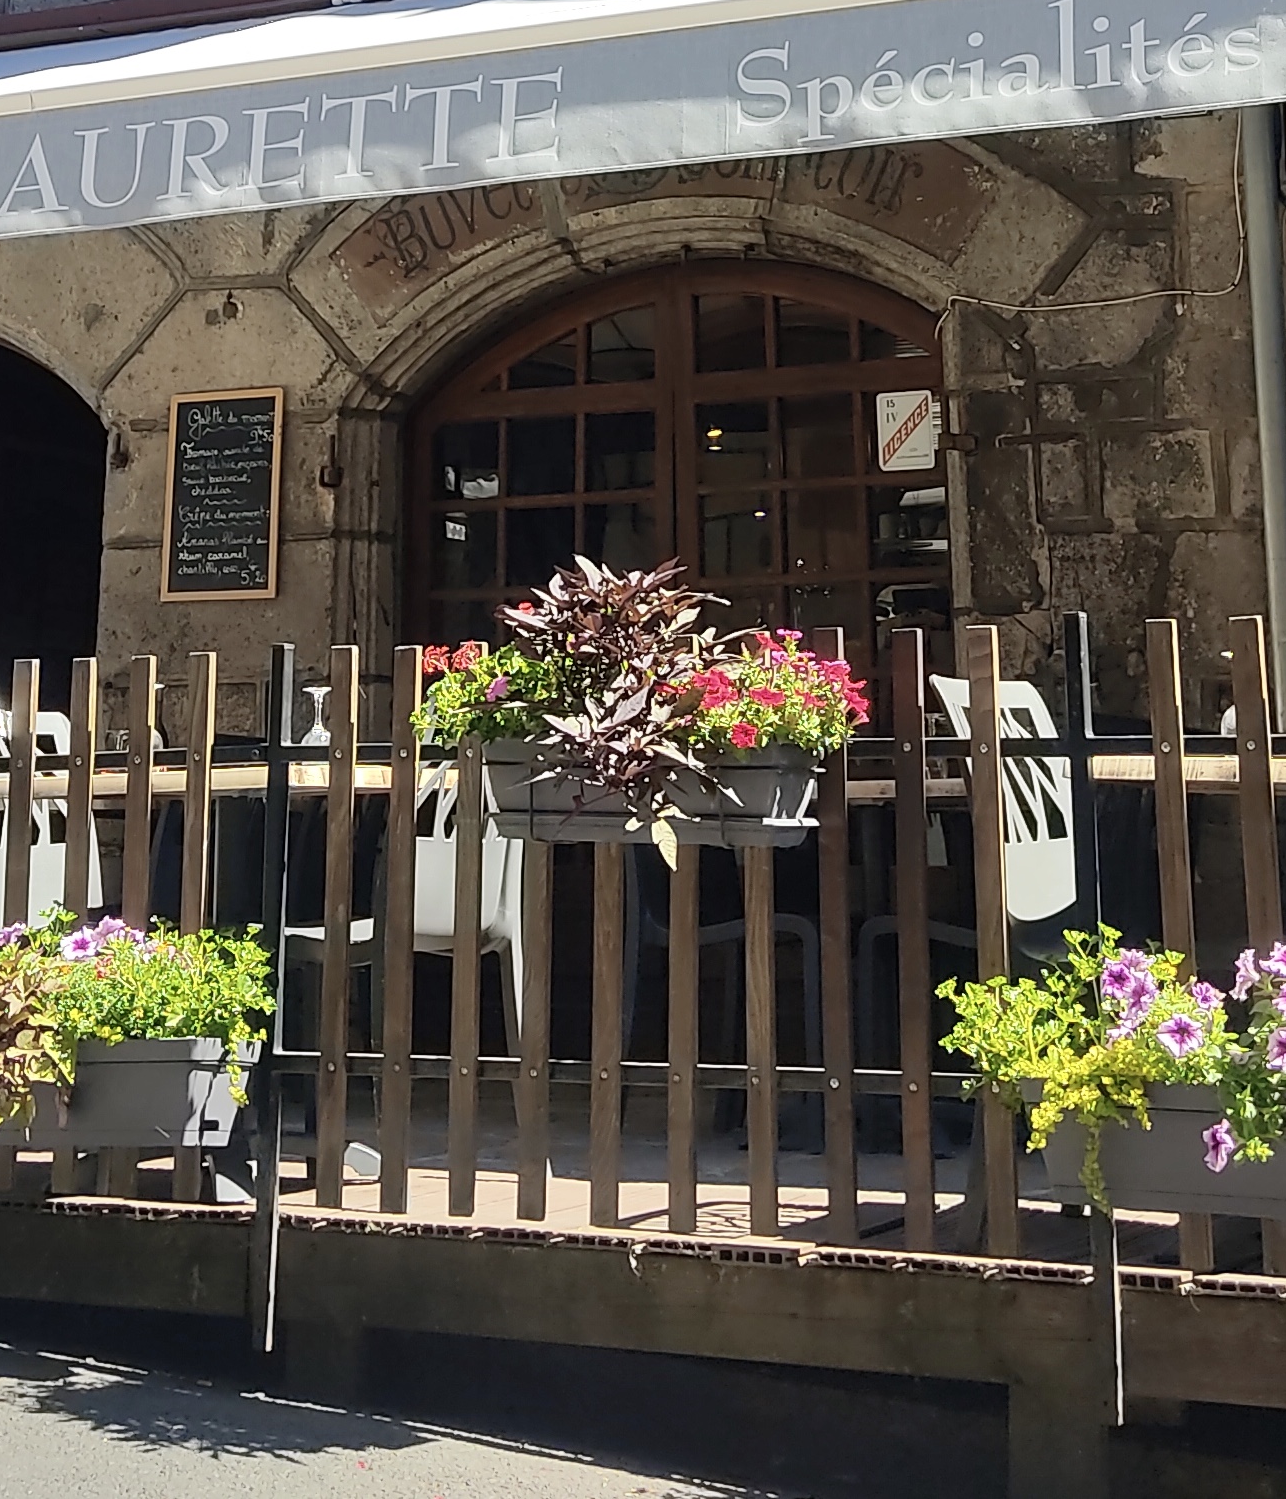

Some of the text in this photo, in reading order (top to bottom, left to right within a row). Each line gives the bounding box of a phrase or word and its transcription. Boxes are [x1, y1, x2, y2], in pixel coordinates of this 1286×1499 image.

[884, 399, 928, 462] LICENCE
[178, 505, 211, 525] Crêpe
[214, 508, 227, 519] du
